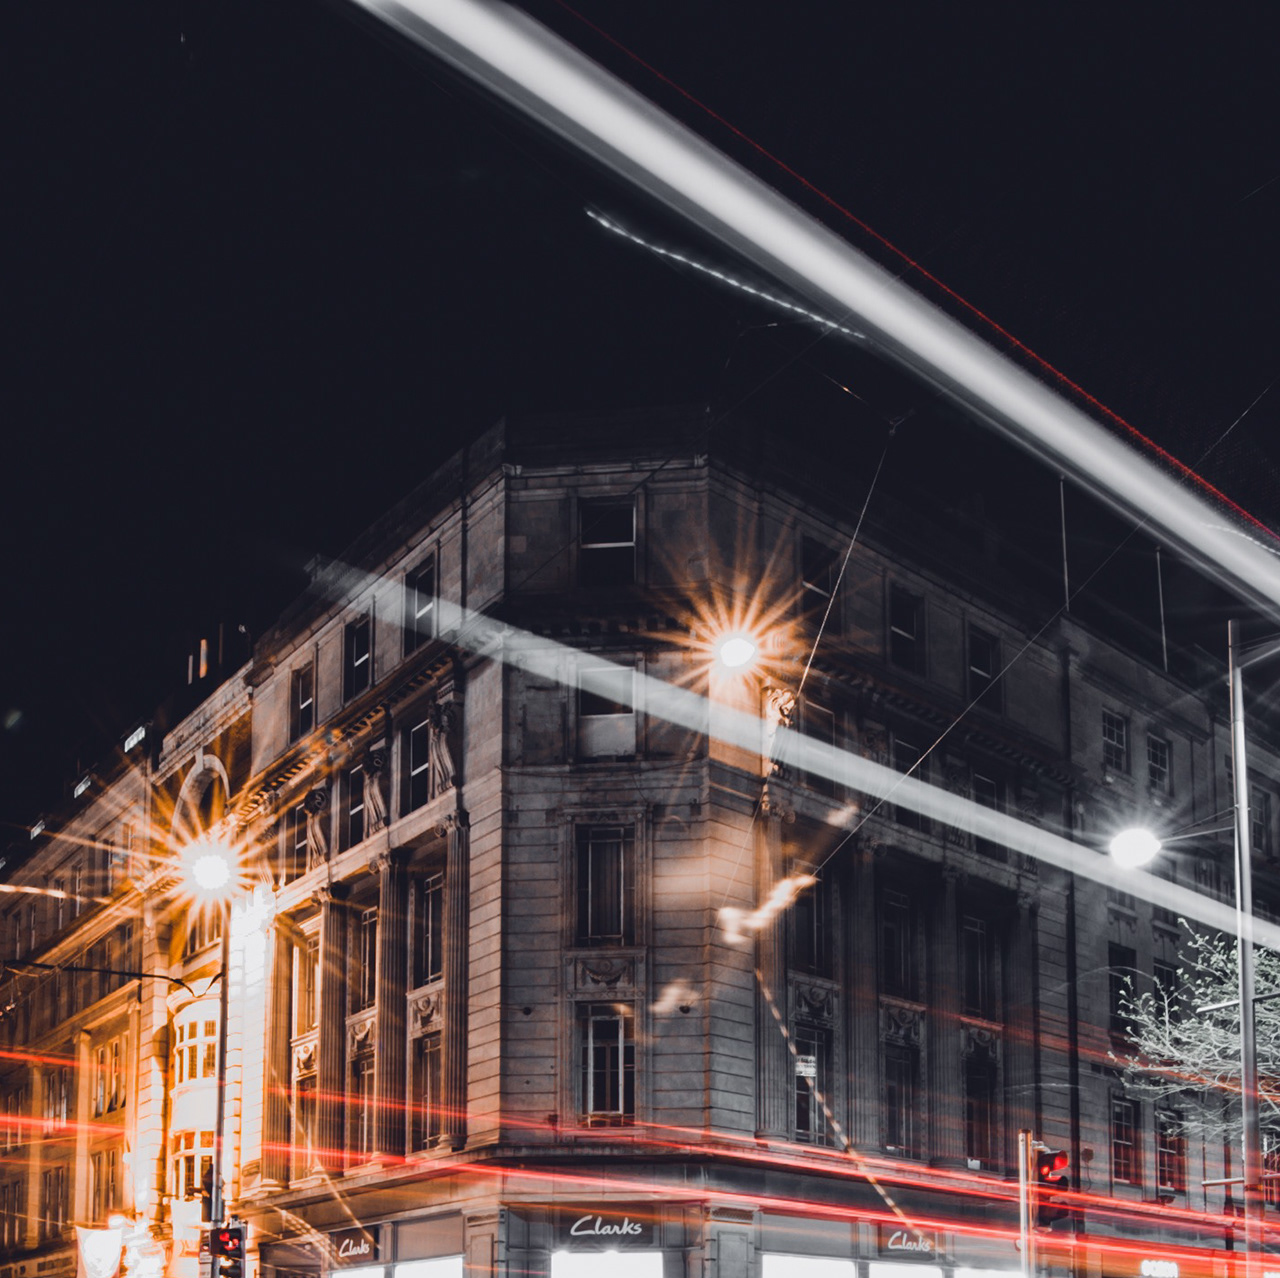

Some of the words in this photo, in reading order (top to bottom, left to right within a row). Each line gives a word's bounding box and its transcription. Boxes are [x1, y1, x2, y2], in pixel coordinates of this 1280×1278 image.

[570, 1215, 642, 1236] Clarks
[339, 1238, 370, 1258] Clarks
[888, 1231, 931, 1252] Clarks
